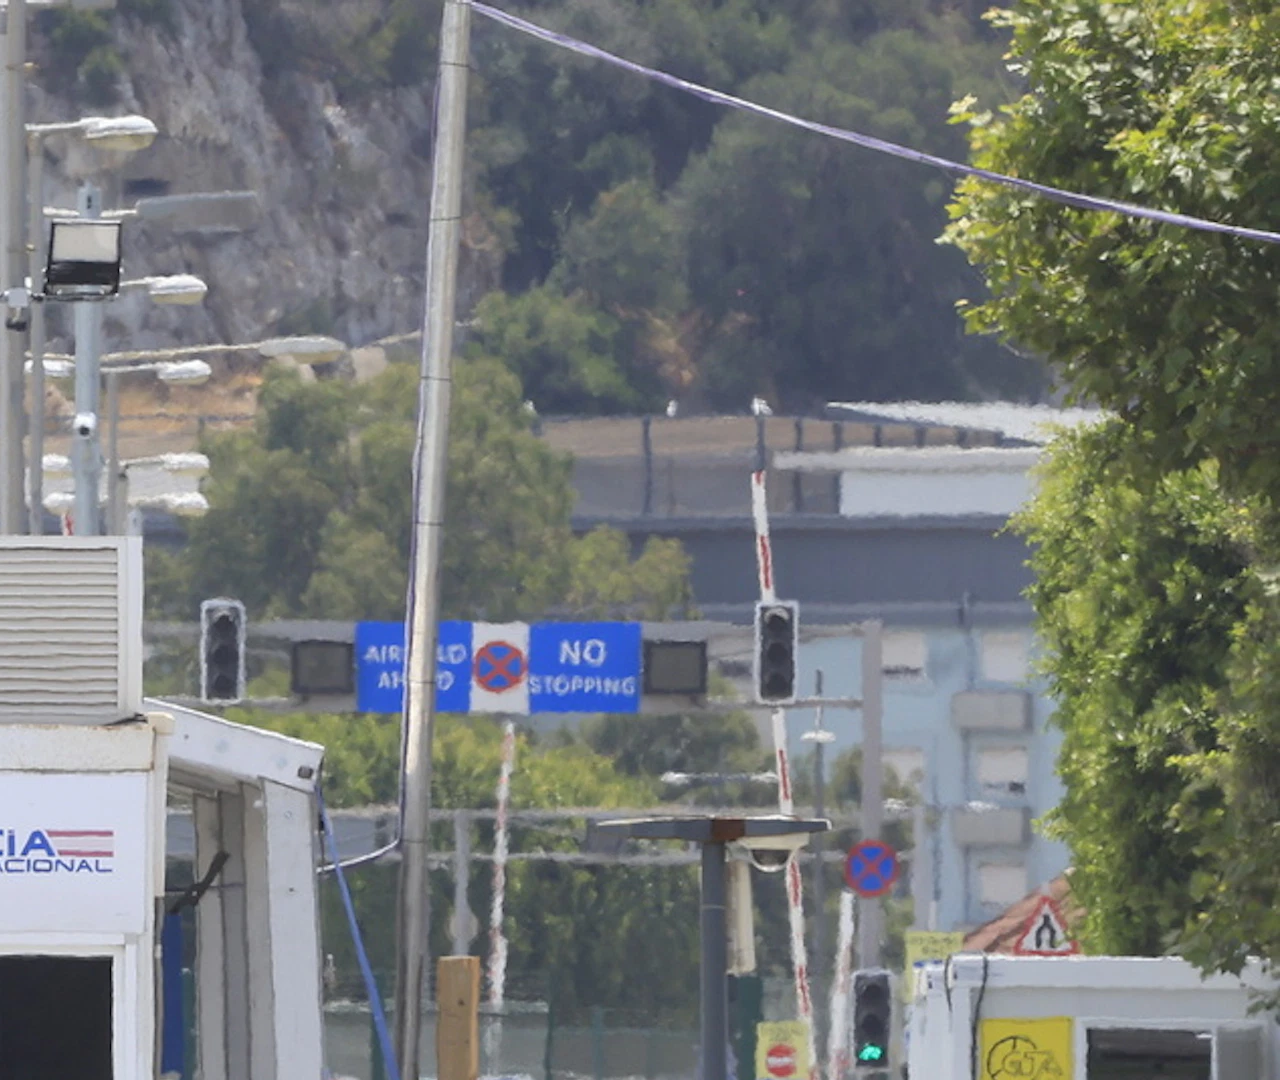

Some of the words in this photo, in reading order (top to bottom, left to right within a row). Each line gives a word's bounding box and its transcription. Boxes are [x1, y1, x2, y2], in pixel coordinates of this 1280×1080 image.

[364, 644, 467, 665] AIRLD
[560, 638, 607, 668] NO
[378, 670, 455, 692] AHD
[529, 673, 636, 697] STOPPING
